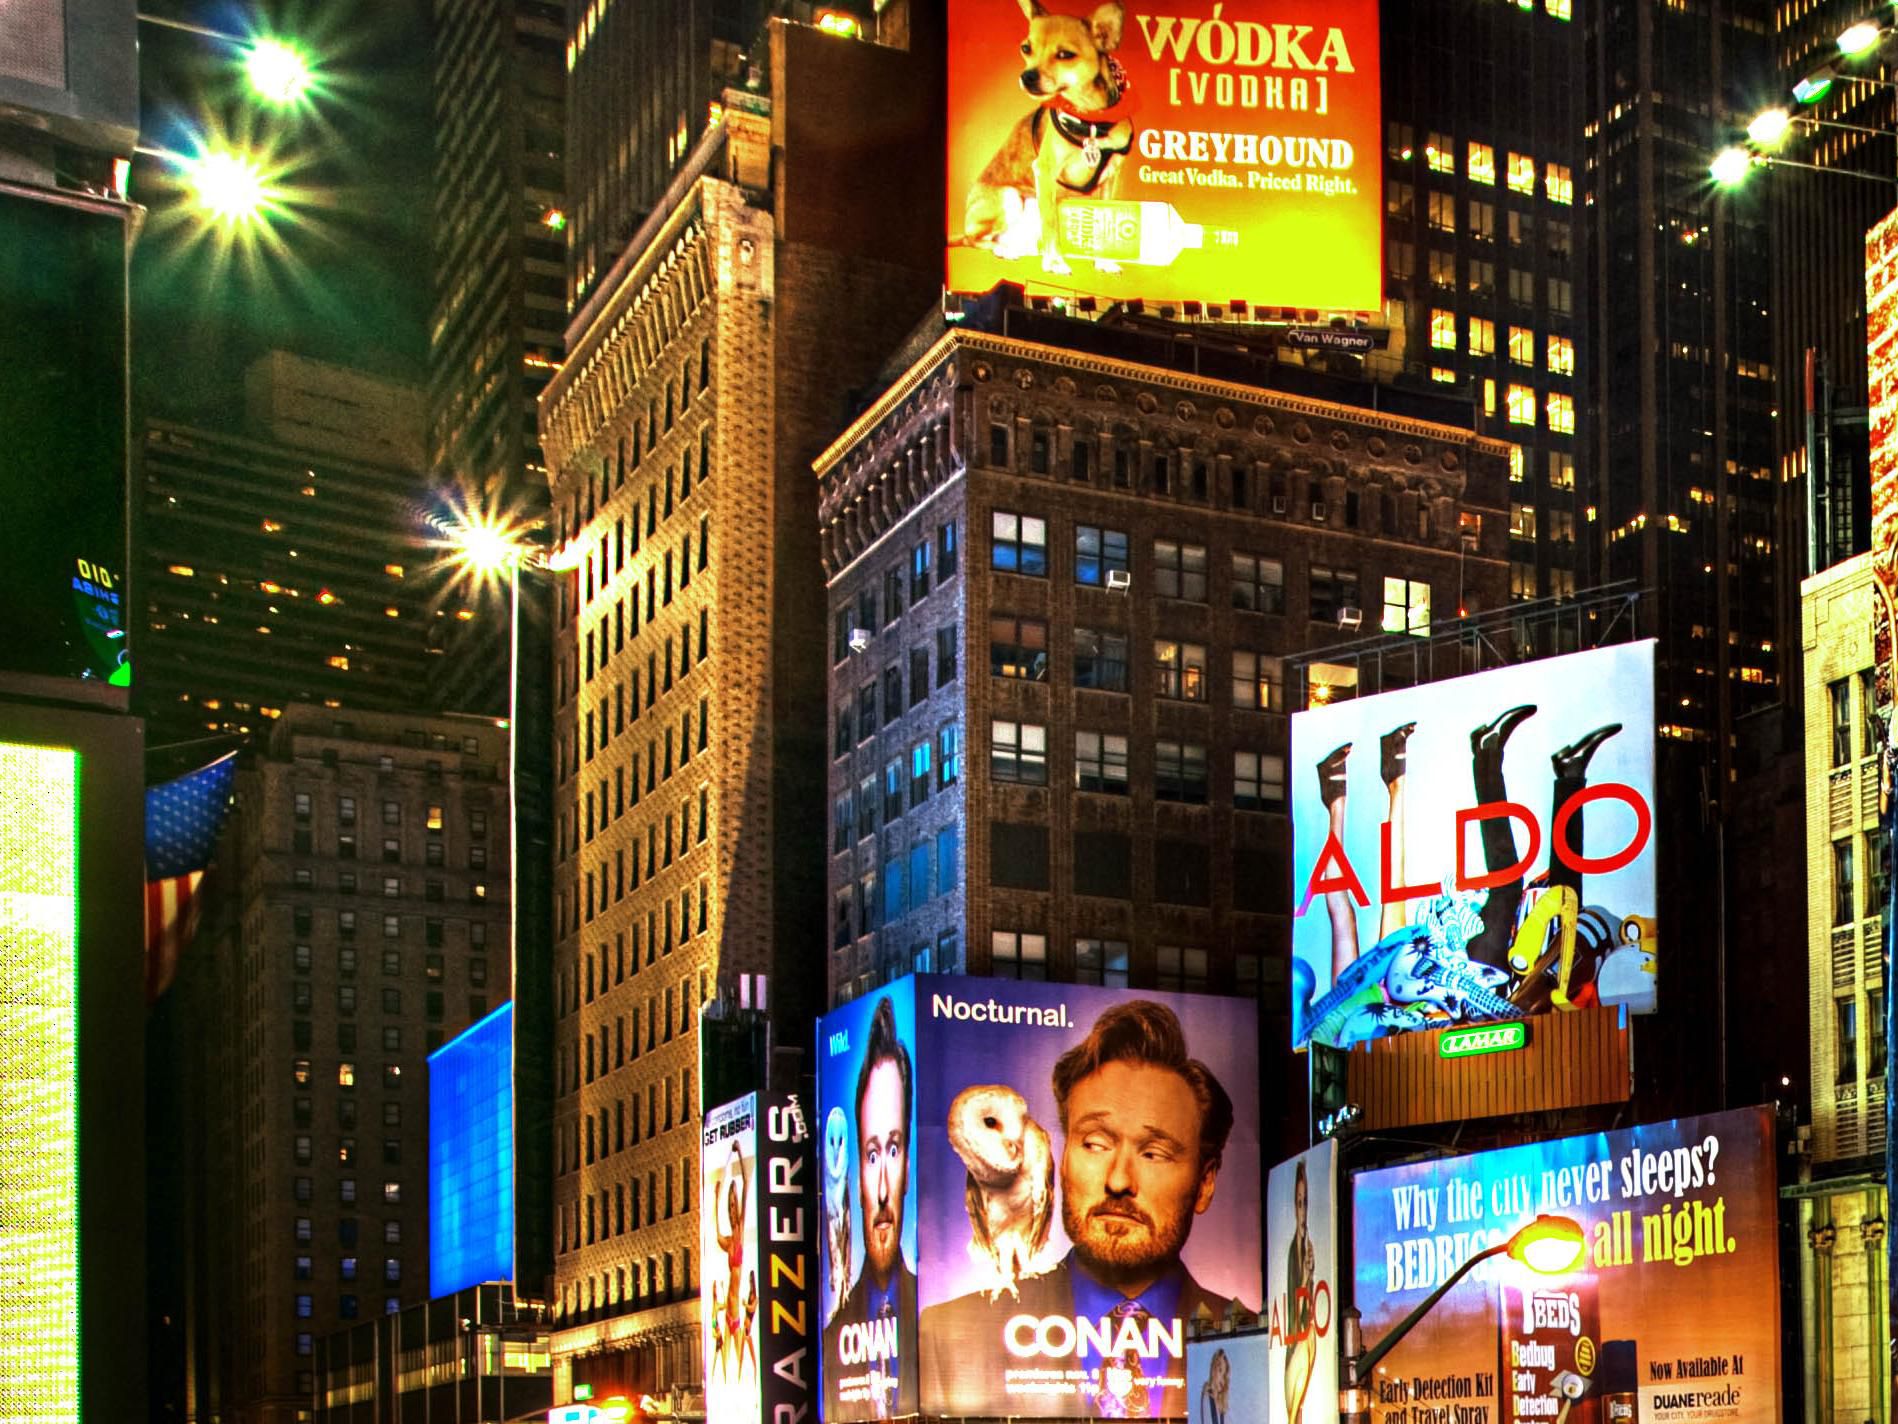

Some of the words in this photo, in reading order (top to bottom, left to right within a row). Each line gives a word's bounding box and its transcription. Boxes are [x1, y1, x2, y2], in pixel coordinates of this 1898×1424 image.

[1137, 2, 1355, 73] WÓDKA
[1139, 129, 1354, 169] GREYHOUND
[1139, 166, 1184, 186] Great
[1186, 168, 1243, 188] Vodka.
[1247, 171, 1301, 192] Priced
[1305, 174, 1357, 195] Right.
[1296, 782, 1652, 918] ALDO
[933, 993, 1075, 1028] Nocturnal.
[829, 1034, 851, 1057] Wild.
[1446, 1028, 1518, 1053] LAMAR
[1392, 1185, 1441, 1232] Why
[1447, 1179, 1481, 1218] the
[1491, 1177, 1533, 1222] city
[1541, 1157, 1613, 1205] never
[1621, 1135, 1720, 1200] sleeps?
[1594, 1210, 1634, 1268] all
[1643, 1197, 1736, 1268] night.
[1269, 1279, 1331, 1349] ALDO
[839, 1316, 898, 1366] CONAN
[1004, 1314, 1183, 1358] CONAN
[1511, 1340, 1555, 1371] Bedbug
[1650, 1361, 1672, 1380] Now
[1676, 1356, 1728, 1379] Available
[1732, 1355, 1743, 1375] At
[1379, 1379, 1409, 1403] Early
[1413, 1375, 1472, 1401] Detection
[1476, 1372, 1493, 1398] Kit
[1512, 1370, 1535, 1394] Early
[1513, 1396, 1558, 1417] Detection
